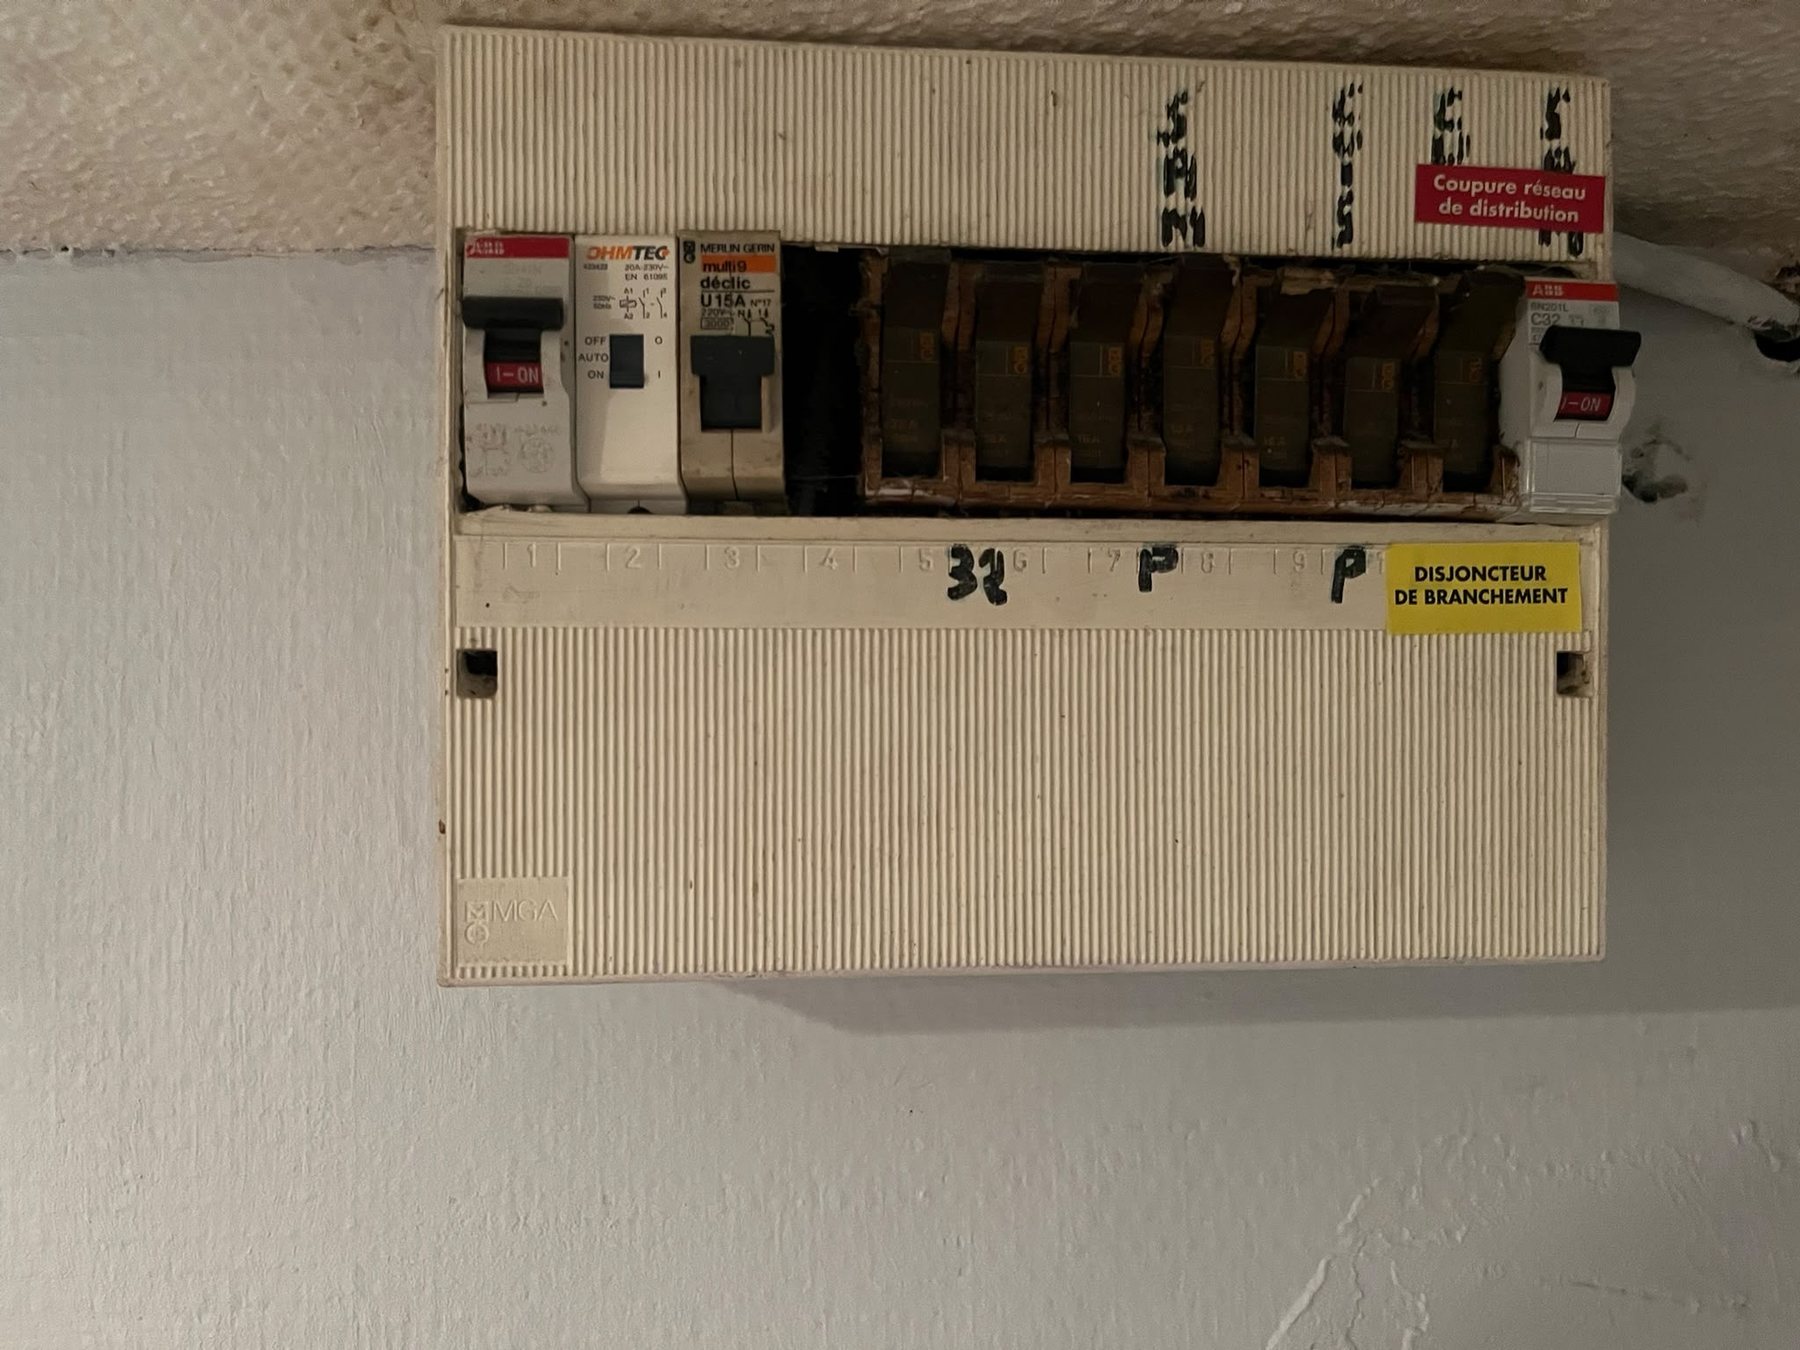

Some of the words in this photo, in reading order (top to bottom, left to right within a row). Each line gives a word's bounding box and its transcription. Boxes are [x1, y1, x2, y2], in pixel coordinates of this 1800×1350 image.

[1433, 174, 1517, 196] Coupure
[1523, 180, 1586, 201] réseau
[1438, 197, 1463, 215] de
[1469, 199, 1579, 223] distribution
[700, 243, 740, 253] MERLIN
[743, 243, 775, 253] GERIN
[625, 273, 638, 281] EN
[700, 276, 751, 289] déclic
[1532, 284, 1565, 297] ABB
[584, 335, 606, 346] OFF
[578, 351, 609, 362] AUTO
[587, 369, 605, 379] ON
[626, 545, 642, 569] 2
[724, 545, 740, 570] 3
[820, 547, 838, 570] 4
[918, 547, 934, 570] 5
[1013, 549, 1027, 572] 6
[1107, 549, 1121, 572] 7
[1292, 550, 1305, 573] 9
[1138, 546, 1179, 592] P
[1331, 545, 1366, 603] P
[1414, 565, 1546, 582] DISJONCTEUR
[1395, 589, 1417, 605] DE
[1424, 588, 1568, 605] BRANCHEMENT
[491, 899, 559, 922] MGA
